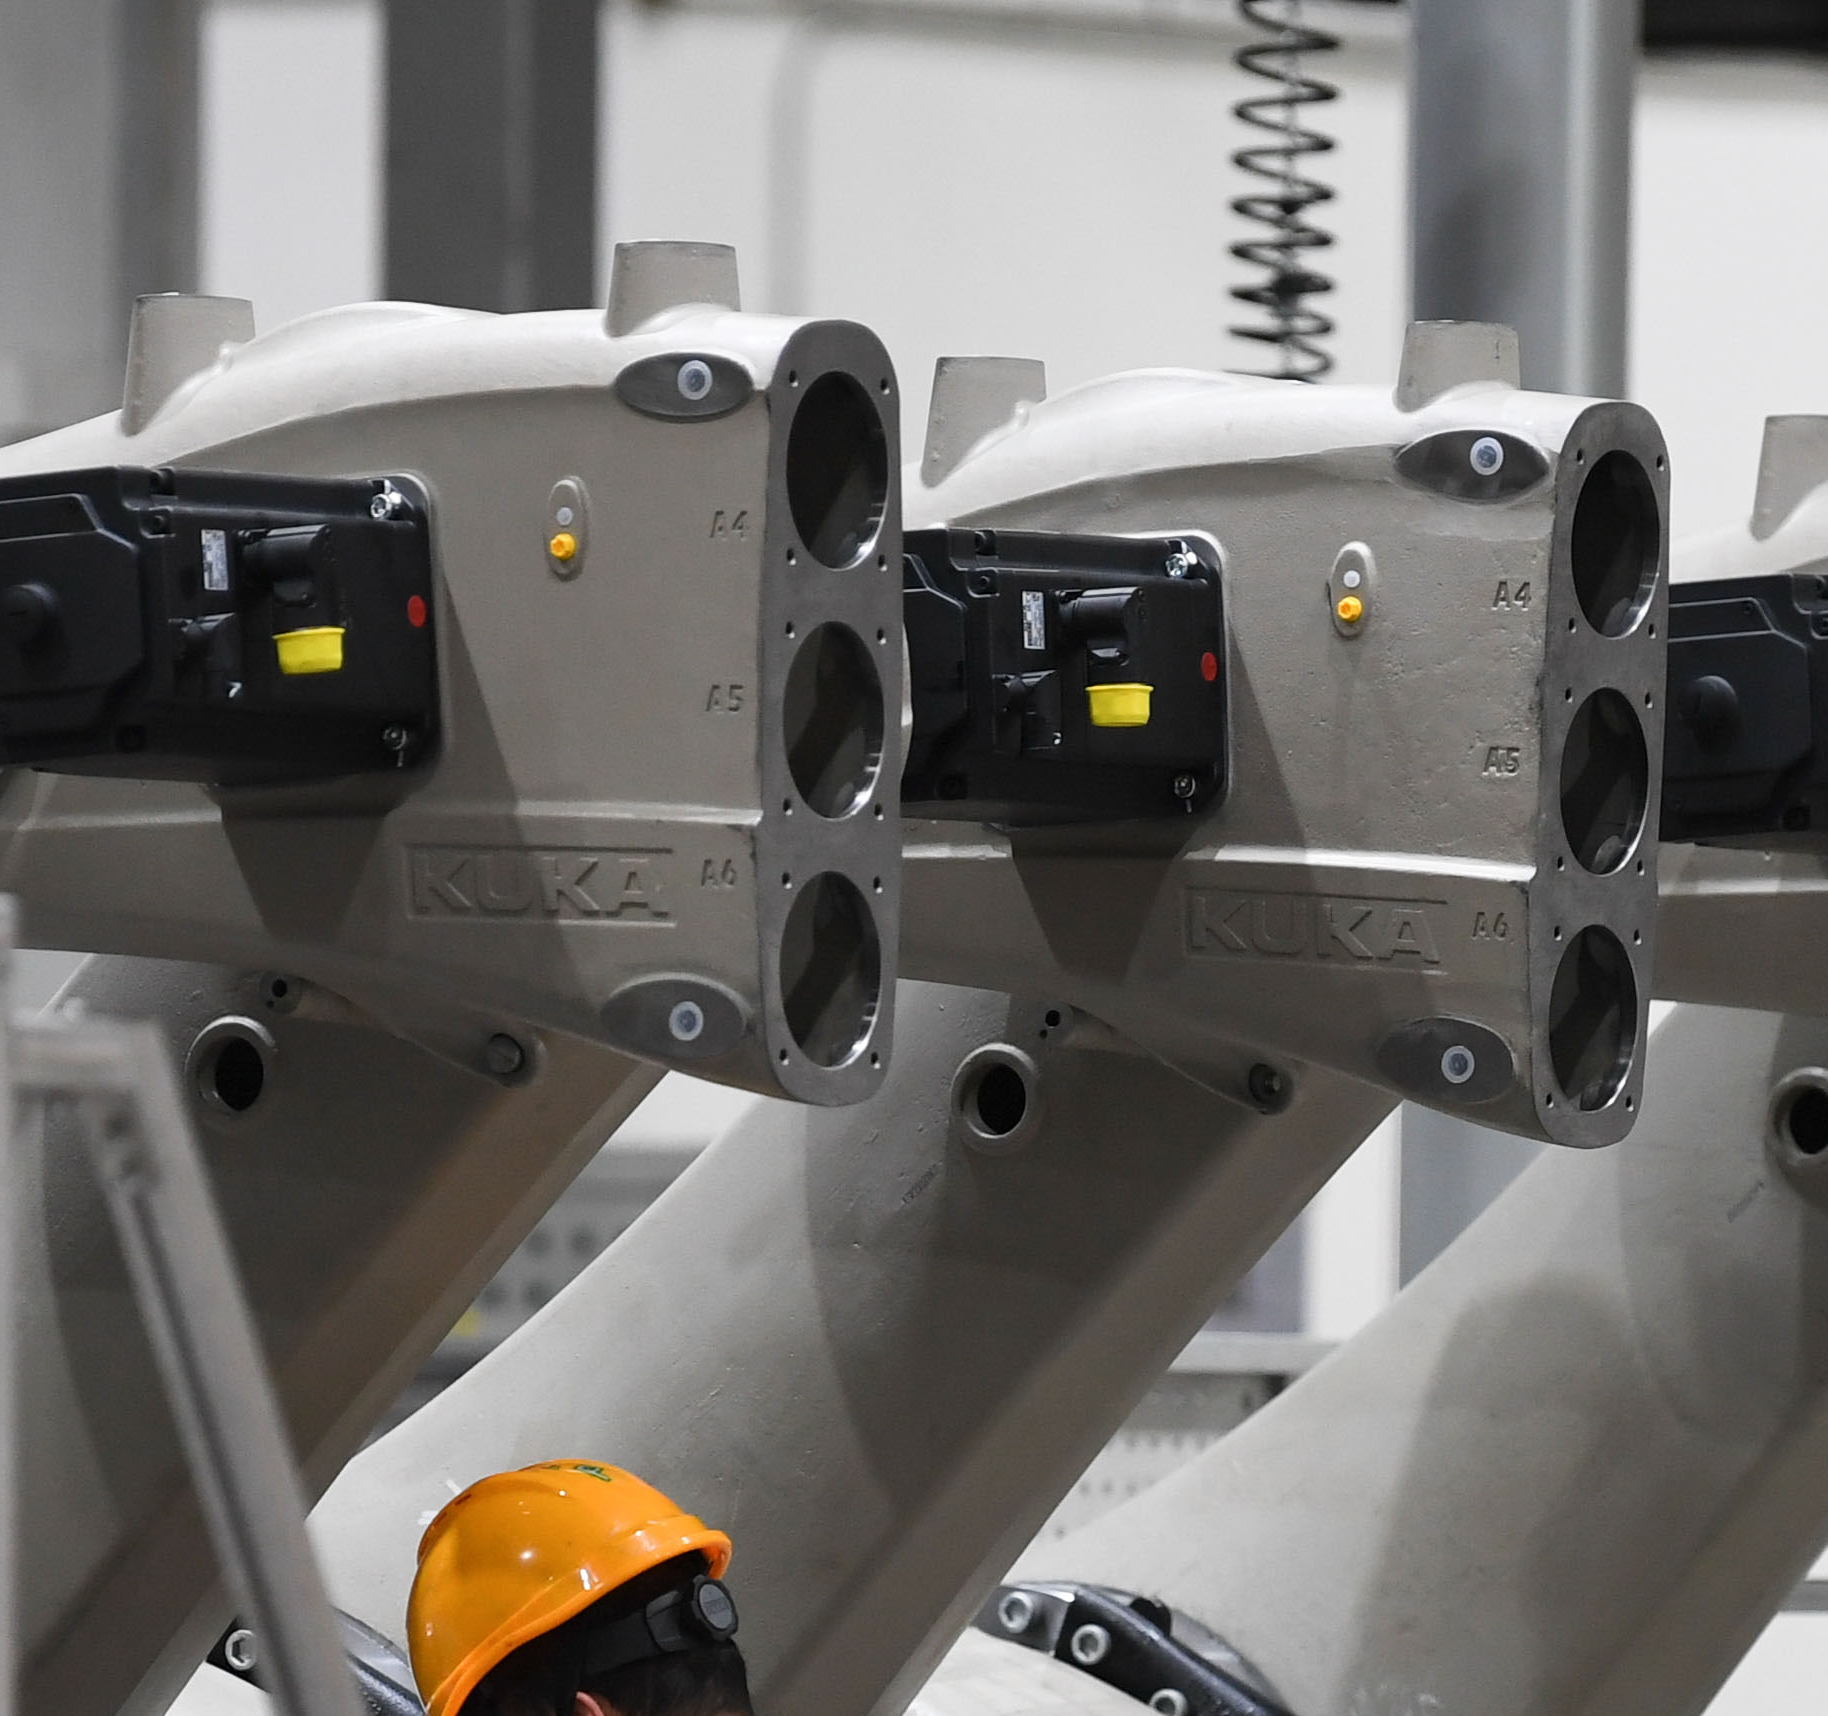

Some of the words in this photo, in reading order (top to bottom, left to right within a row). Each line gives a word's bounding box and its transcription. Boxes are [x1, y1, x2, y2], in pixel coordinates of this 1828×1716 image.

[709, 509, 751, 540] A4
[1490, 580, 1534, 612] A4
[704, 682, 746, 714] A5
[1481, 745, 1522, 778] A5
[413, 855, 670, 918] KUKA
[699, 857, 739, 888] A6
[1186, 893, 1442, 965] KUKA
[1471, 912, 1510, 942] A6
